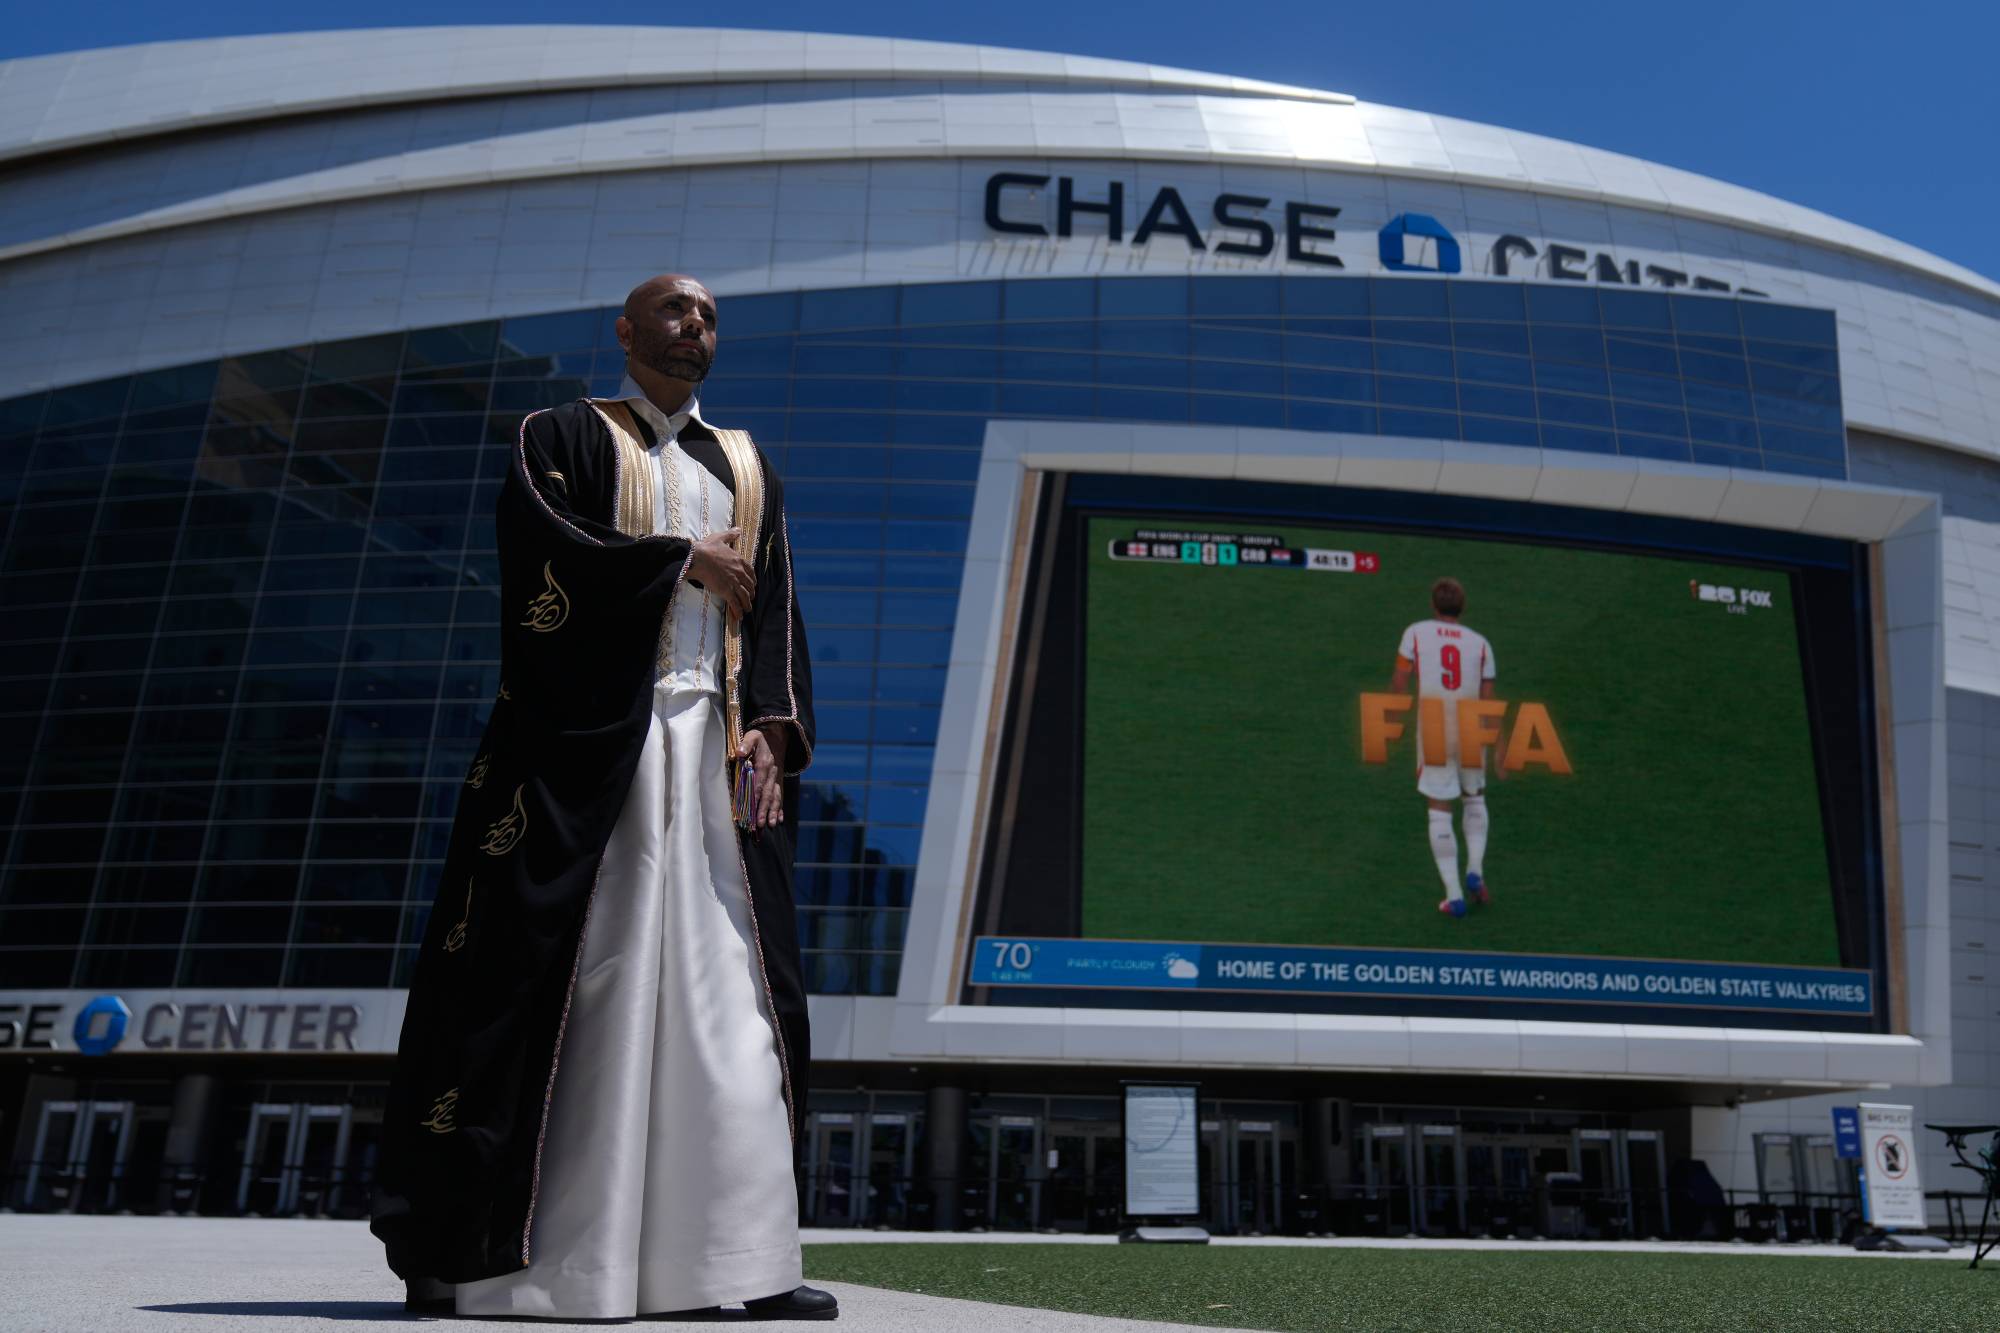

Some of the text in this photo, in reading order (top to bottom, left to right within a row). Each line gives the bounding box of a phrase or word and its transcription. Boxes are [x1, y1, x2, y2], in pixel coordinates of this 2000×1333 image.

[984, 171, 1344, 268] CHASE
[1152, 543, 1177, 558] ENG
[1187, 546, 1196, 558] 2
[1241, 548, 1267, 562] CRO
[1359, 557, 1375, 569] +5
[1740, 588, 1772, 607] FOX
[1440, 644, 1462, 691] 9
[1360, 692, 1573, 775] FIFA
[1217, 960, 1866, 1002] HOME OF THE GOLDEN STATE WARRIORS AND GOLDEN STATE VALKYRIES
[141, 1003, 361, 1050] CENTER
